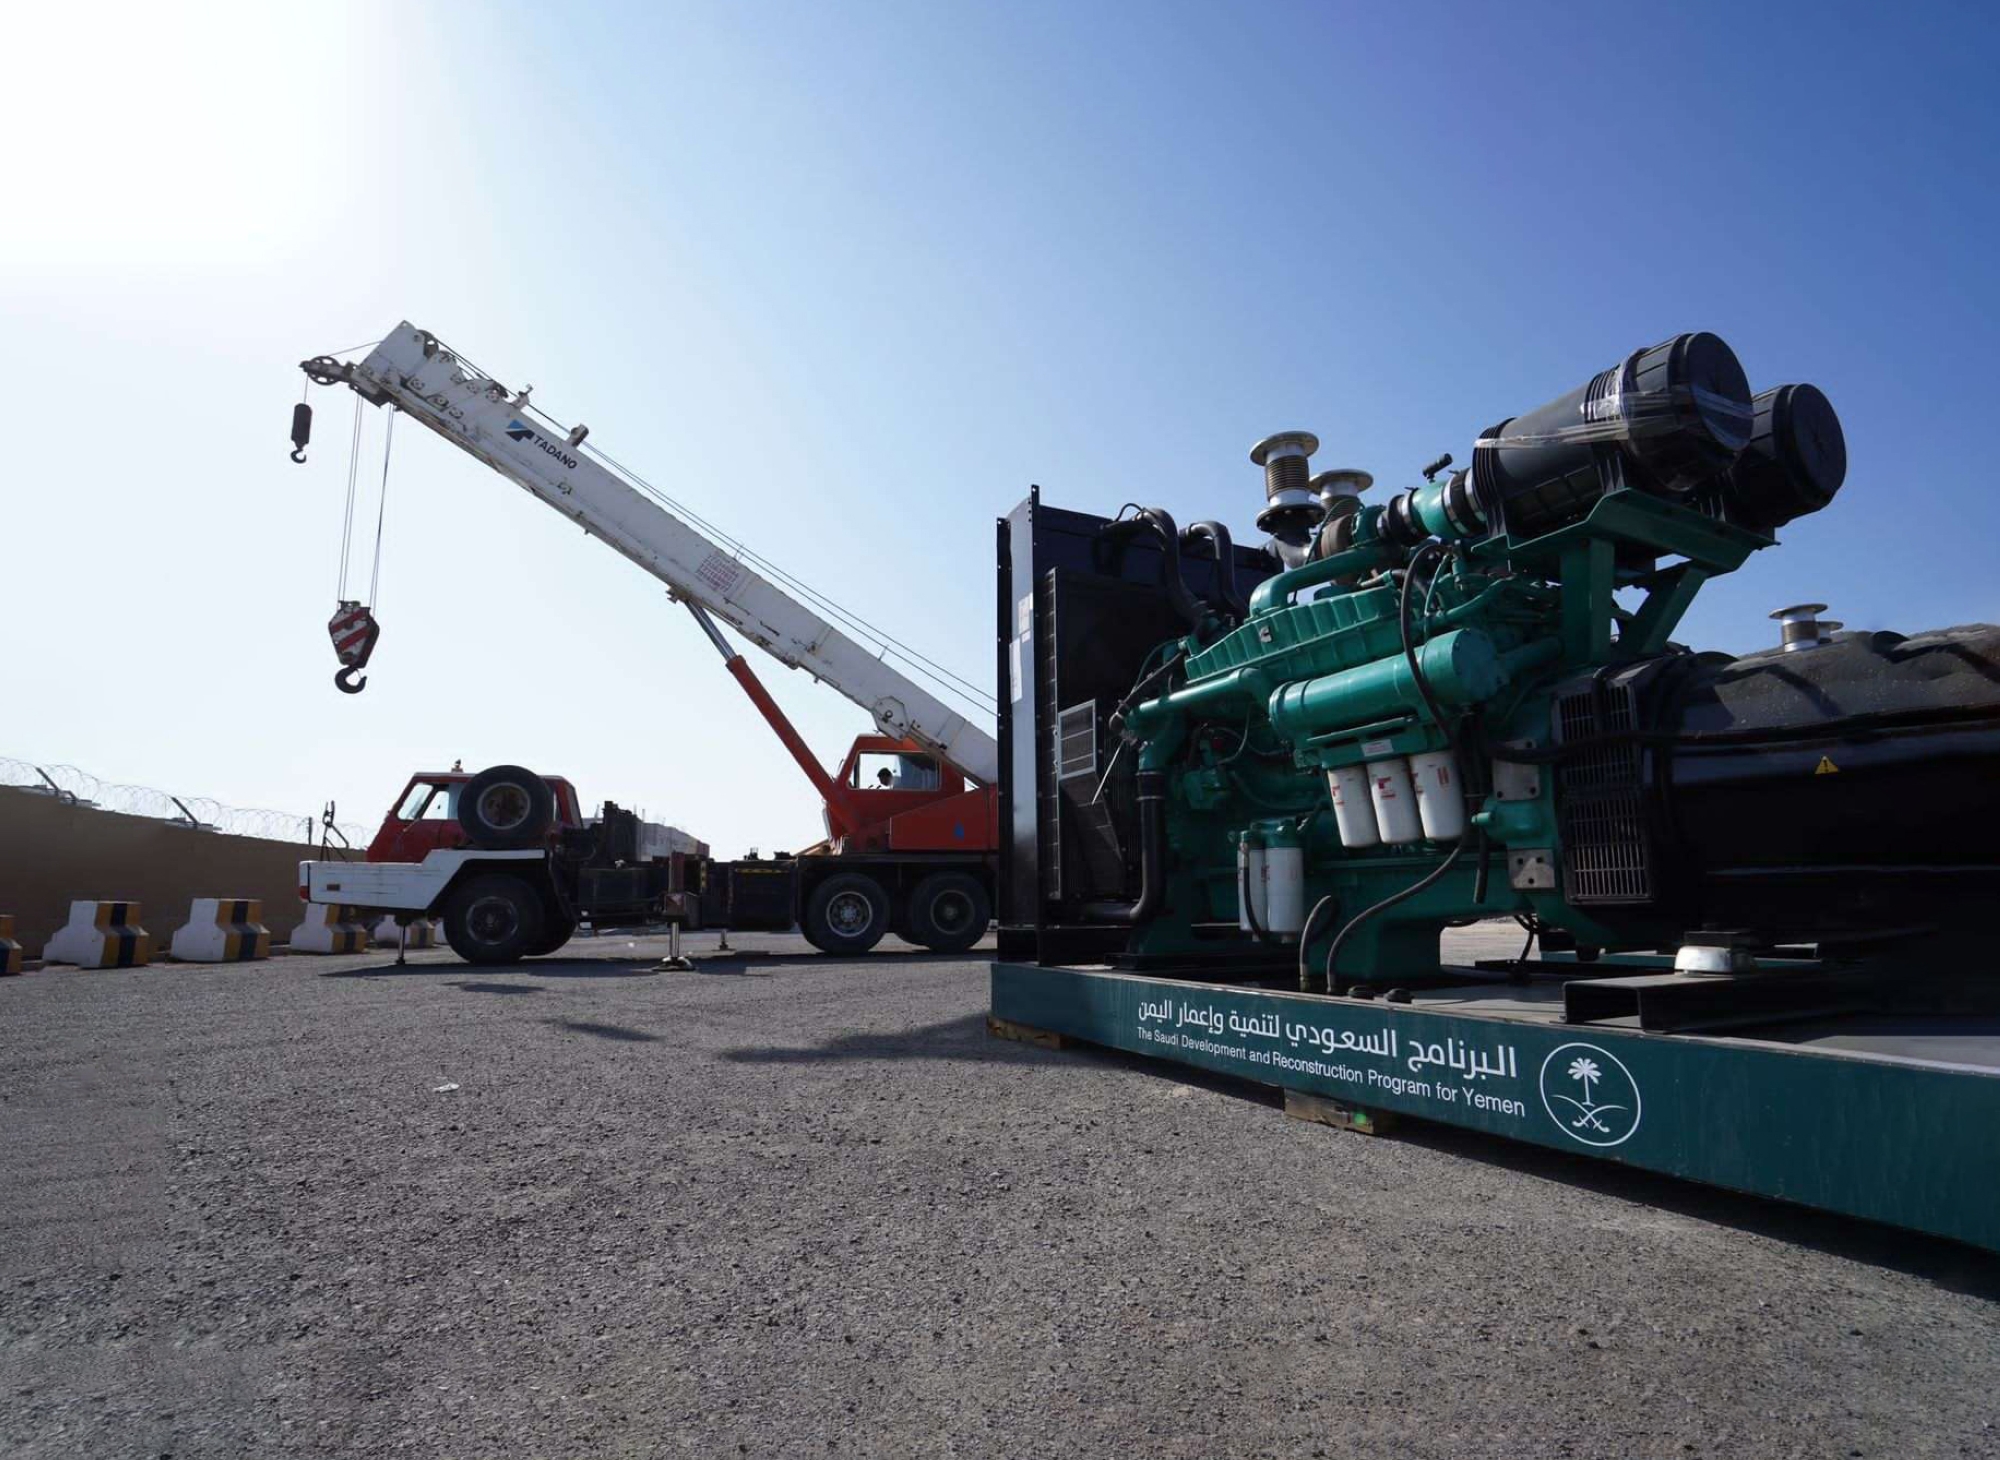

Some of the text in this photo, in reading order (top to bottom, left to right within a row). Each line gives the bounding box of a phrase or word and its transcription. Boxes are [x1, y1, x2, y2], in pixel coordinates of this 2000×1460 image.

[533, 436, 578, 469] TADANO
[1137, 1027, 1525, 1117] The Saudi Development and Reconstruction Program for Yemen
[1138, 999, 1516, 1080] البرنامج السعودي لتنمية وإعمار اليمن
